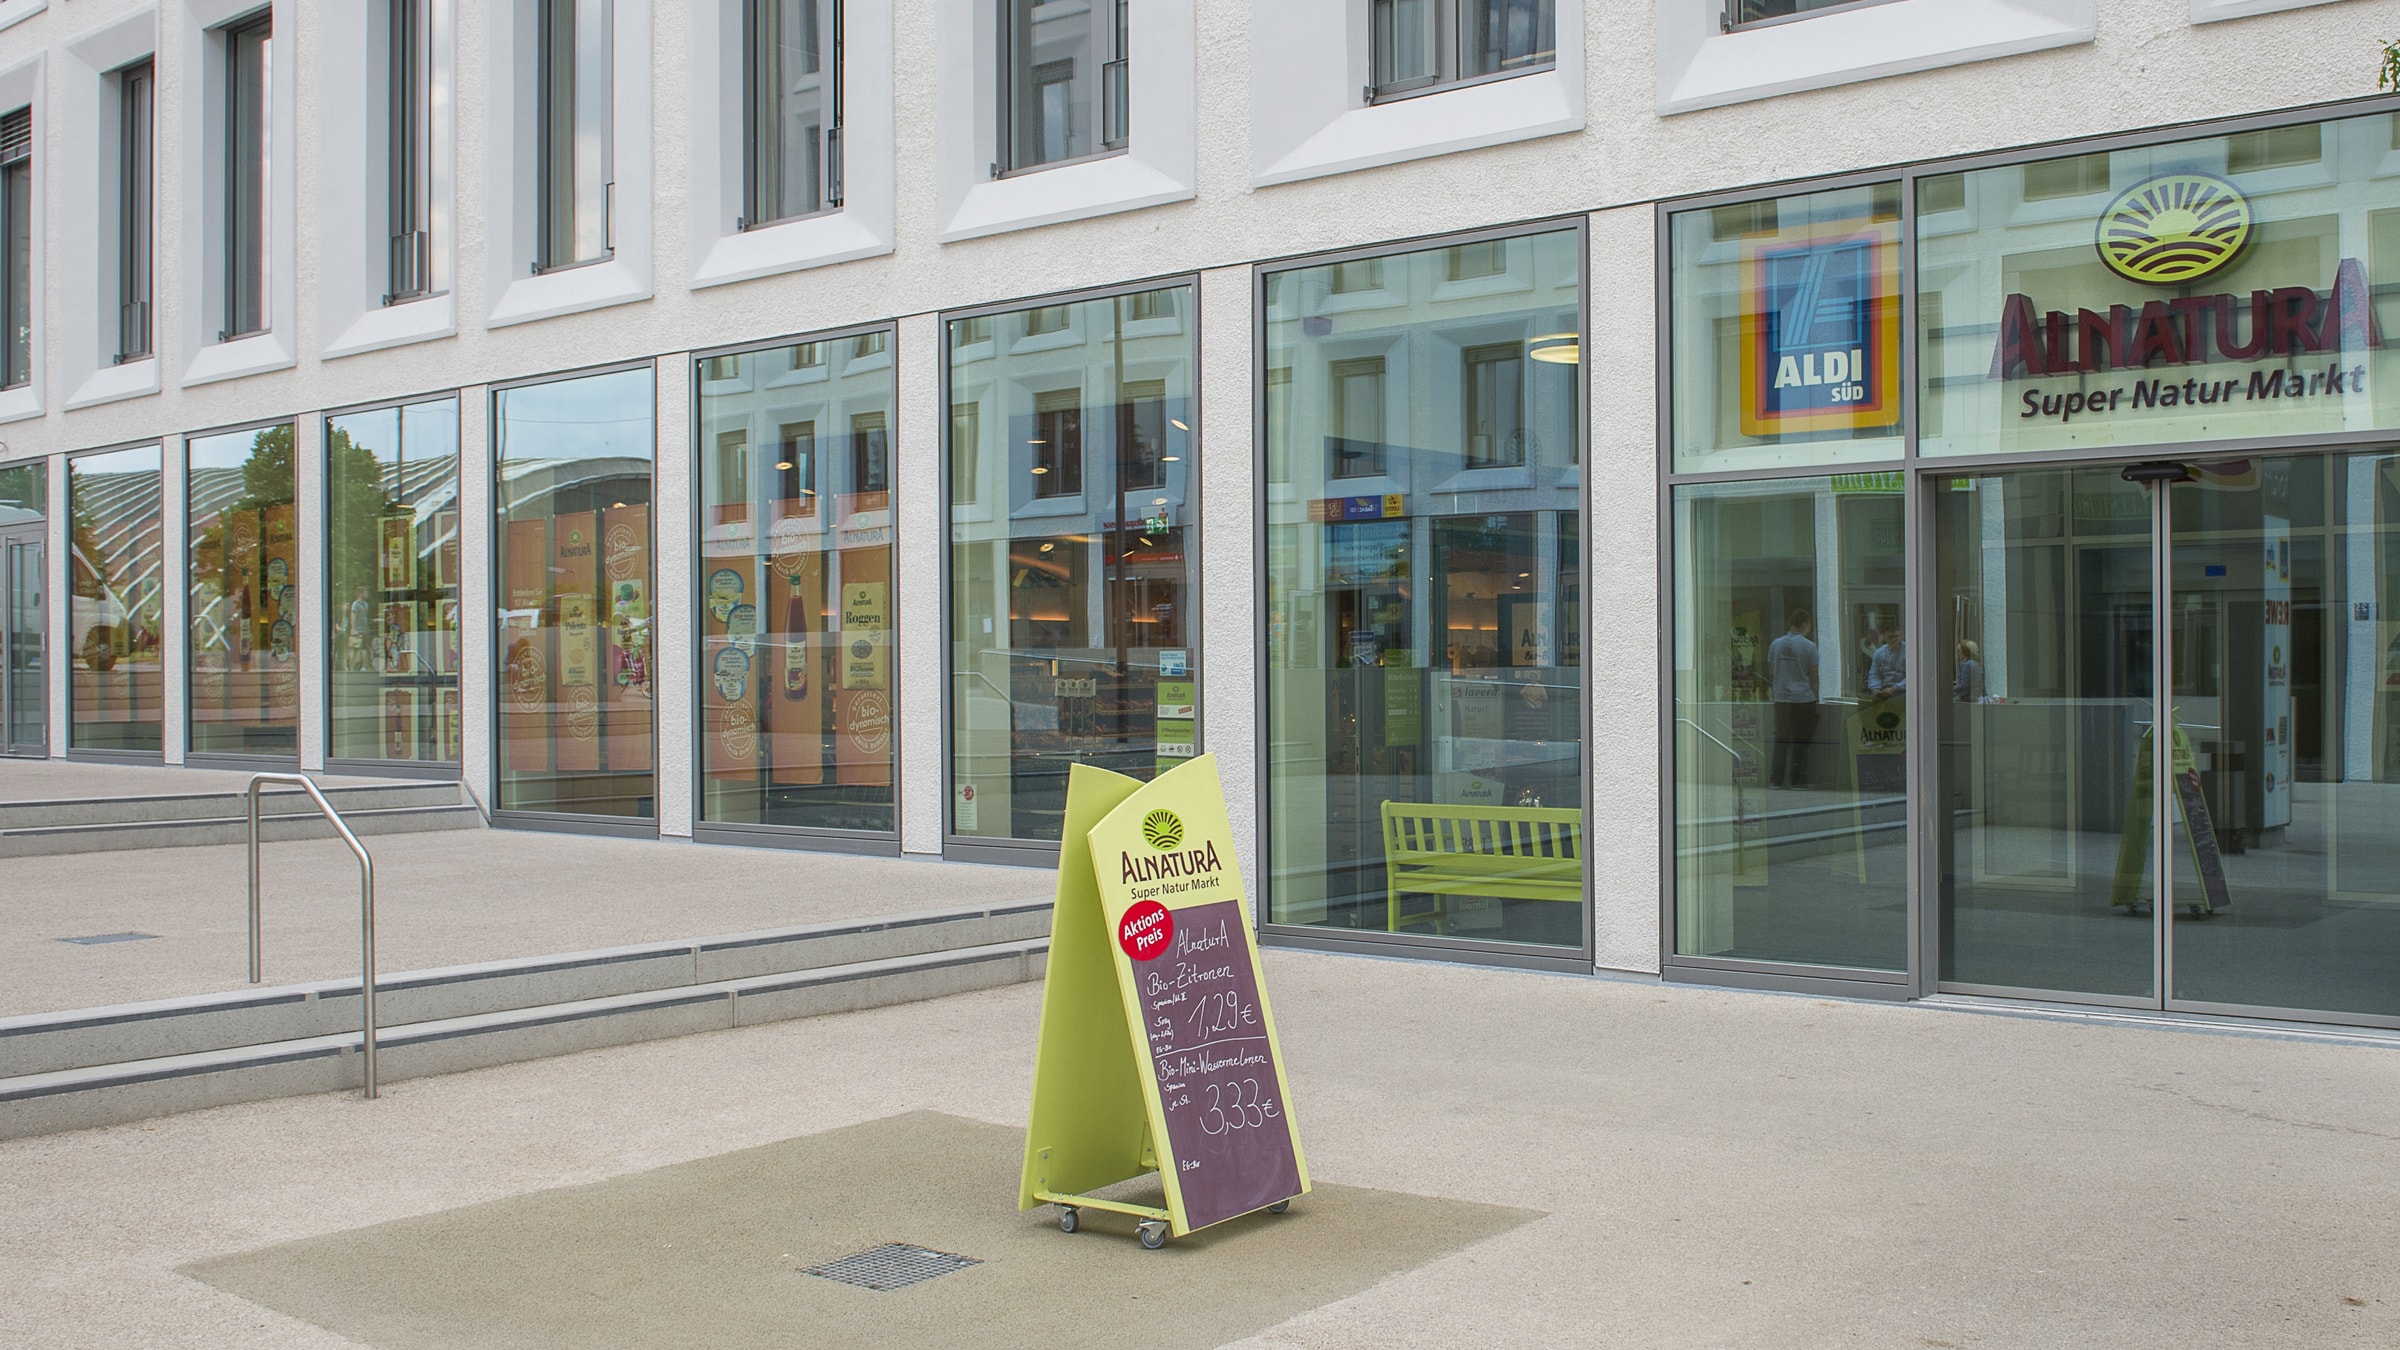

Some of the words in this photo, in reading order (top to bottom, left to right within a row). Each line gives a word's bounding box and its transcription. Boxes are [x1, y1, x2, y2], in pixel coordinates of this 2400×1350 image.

[1988, 258, 2384, 380] ALNATURA
[1774, 349, 1862, 389] ALDI
[1831, 382, 1864, 402] SÜD
[2020, 386, 2123, 421] Super
[2132, 378, 2238, 409] Natur
[2247, 363, 2366, 399] Markt
[845, 611, 881, 627] Roggen
[1465, 686, 1498, 697] lavera
[850, 714, 890, 732] dynamisch
[1121, 840, 1222, 884] ALNATURA
[1131, 886, 1159, 901] Super
[1162, 881, 1189, 896] Natur
[1191, 876, 1220, 891] Markt
[1123, 908, 1165, 940] Aktions
[1136, 927, 1164, 951] Preis
